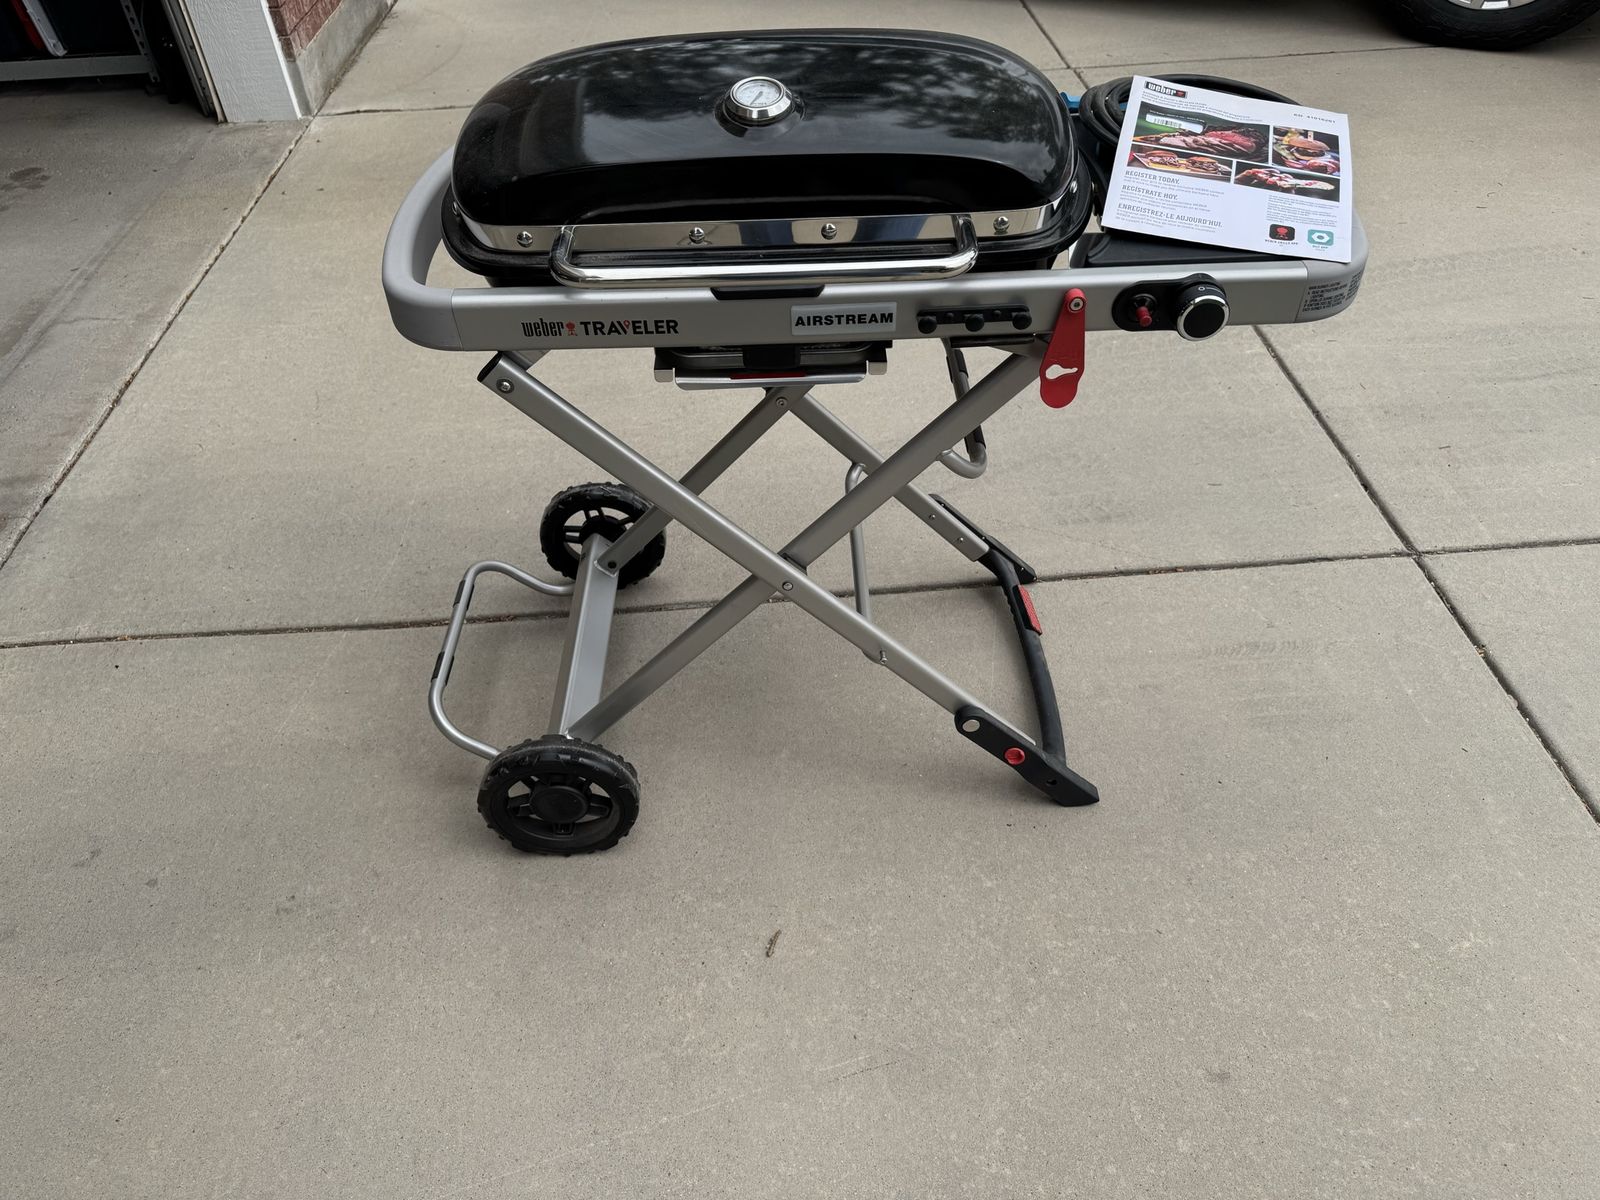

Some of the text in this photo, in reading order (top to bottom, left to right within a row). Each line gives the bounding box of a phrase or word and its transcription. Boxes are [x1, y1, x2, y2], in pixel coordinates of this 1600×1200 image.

[1148, 82, 1177, 96] weber
[1125, 170, 1180, 185] REGISTER TODAY.
[1163, 192, 1178, 200] HOY.
[1175, 213, 1223, 228] AUJOURD'HUI.
[795, 312, 894, 327] AIRSTREAM
[521, 318, 680, 337] weber TRAVELER
